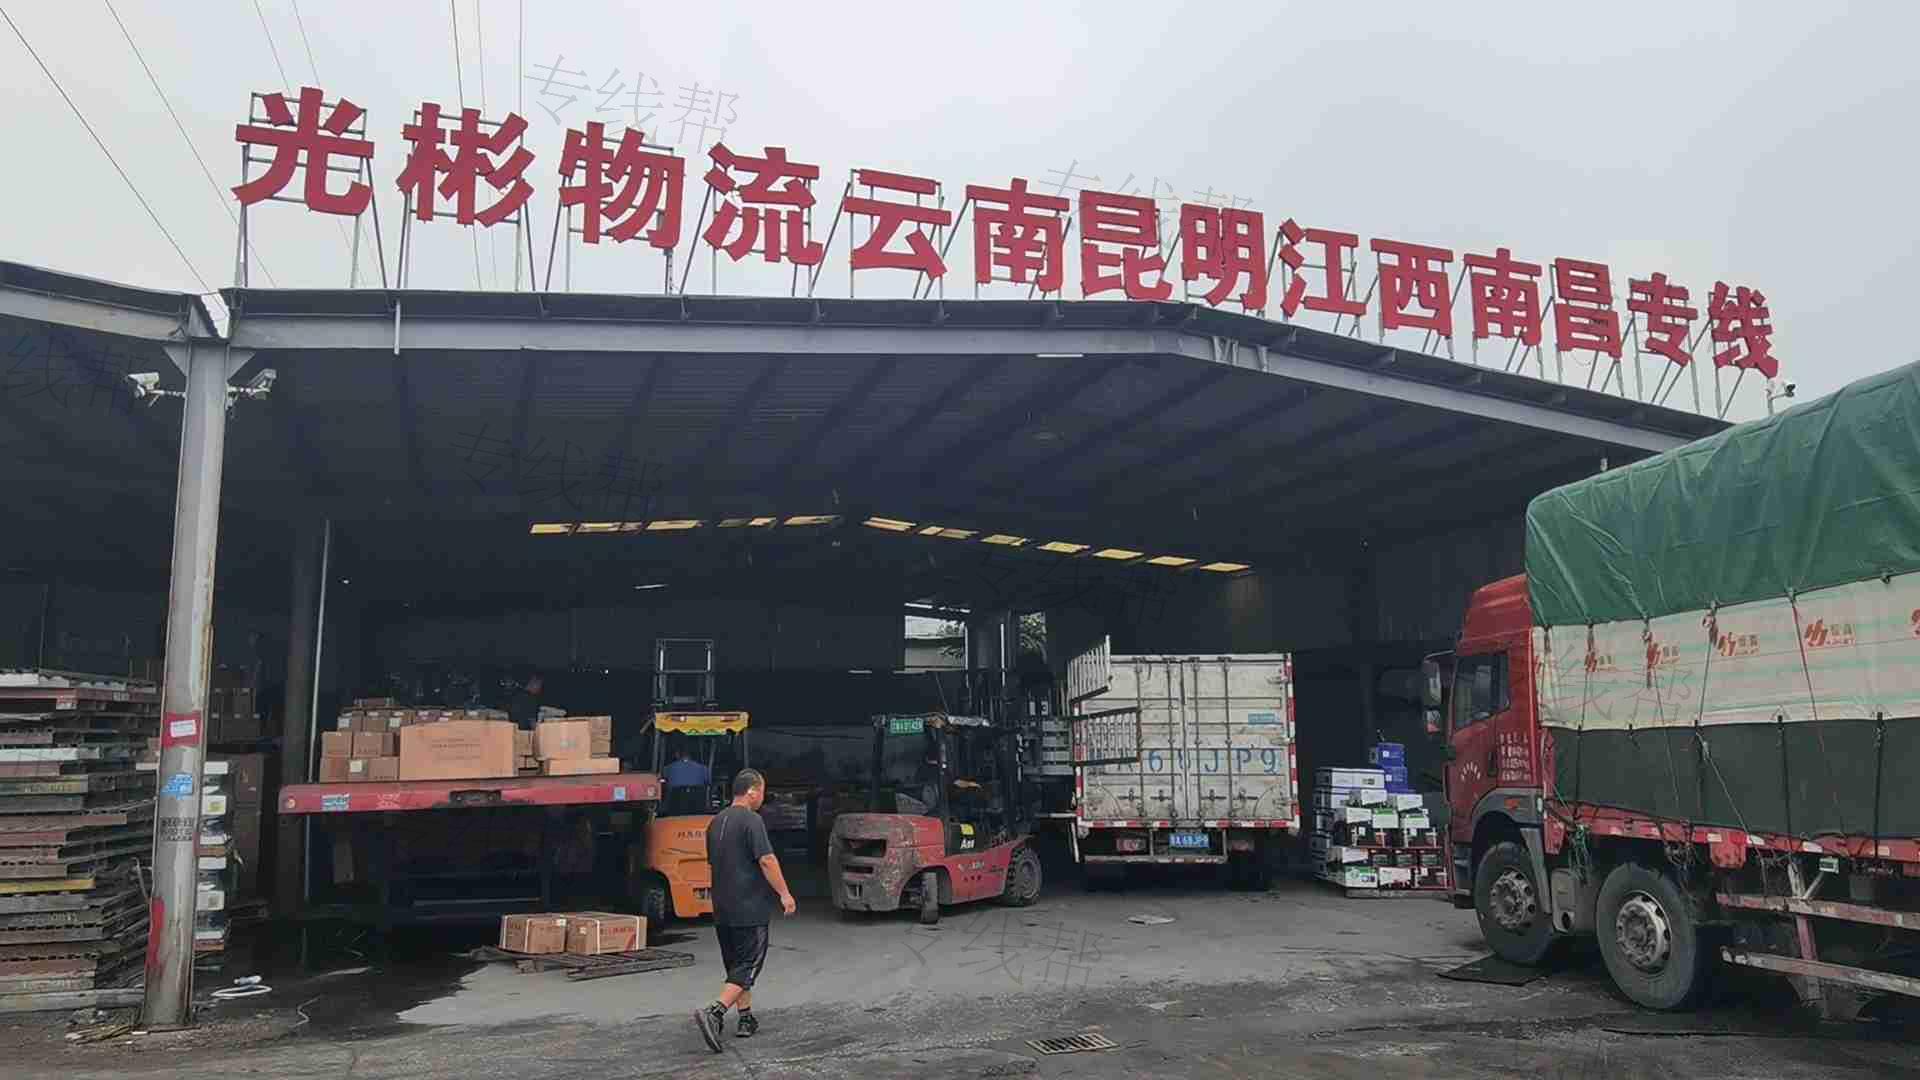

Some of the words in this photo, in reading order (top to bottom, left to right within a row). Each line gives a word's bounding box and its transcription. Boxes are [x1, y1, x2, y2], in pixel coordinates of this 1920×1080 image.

[231, 86, 1779, 378] 光彬物流云南昆明江西南昌专线
